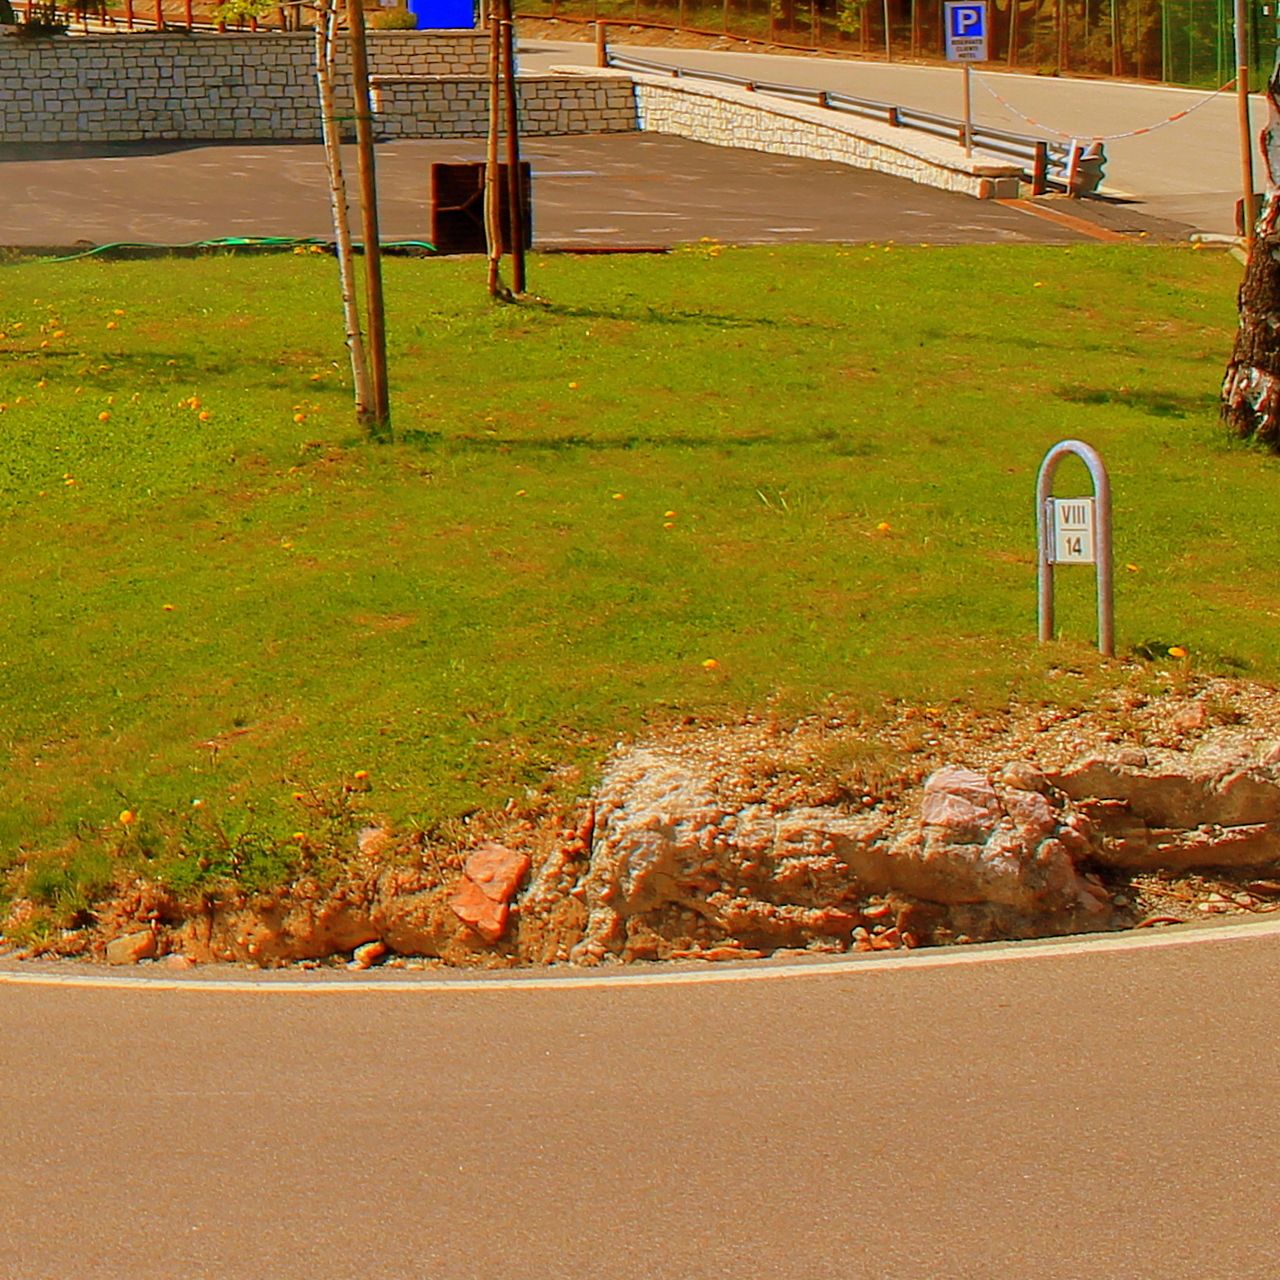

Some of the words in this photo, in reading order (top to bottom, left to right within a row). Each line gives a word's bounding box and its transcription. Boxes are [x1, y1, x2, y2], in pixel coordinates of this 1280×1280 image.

[958, 9, 978, 34] P
[1060, 505, 1086, 524] VIII
[1065, 537, 1082, 556] 14
